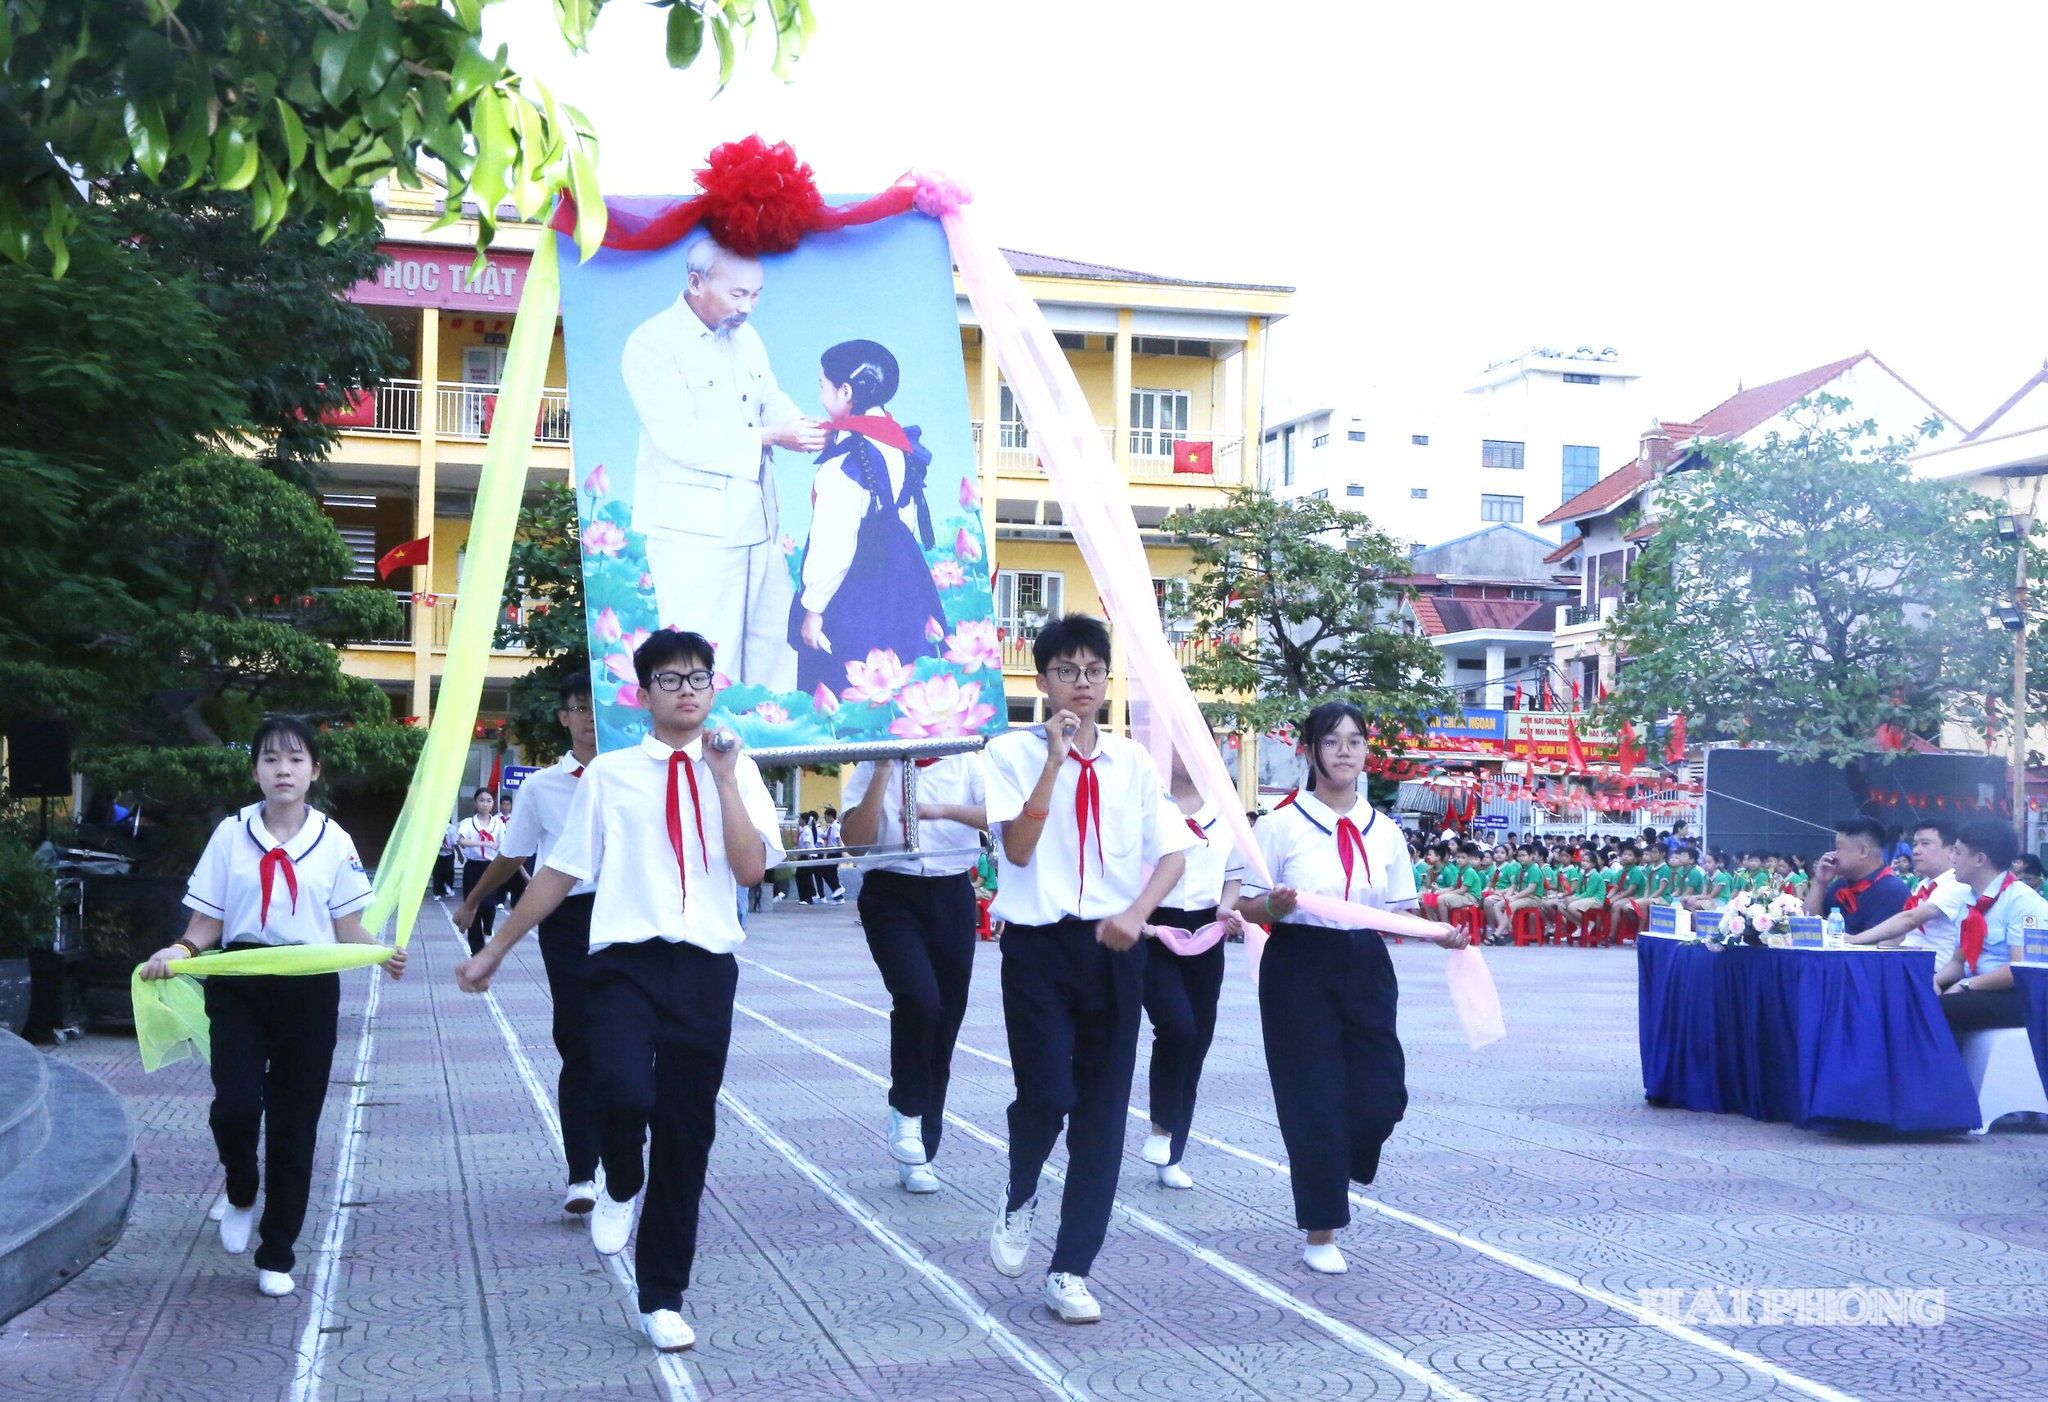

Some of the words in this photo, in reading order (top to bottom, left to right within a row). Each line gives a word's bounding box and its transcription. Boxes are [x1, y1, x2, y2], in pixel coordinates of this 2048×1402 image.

[384, 260, 440, 296] HỌC
[448, 261, 517, 301] THẬT
[506, 778, 520, 786] KIM
